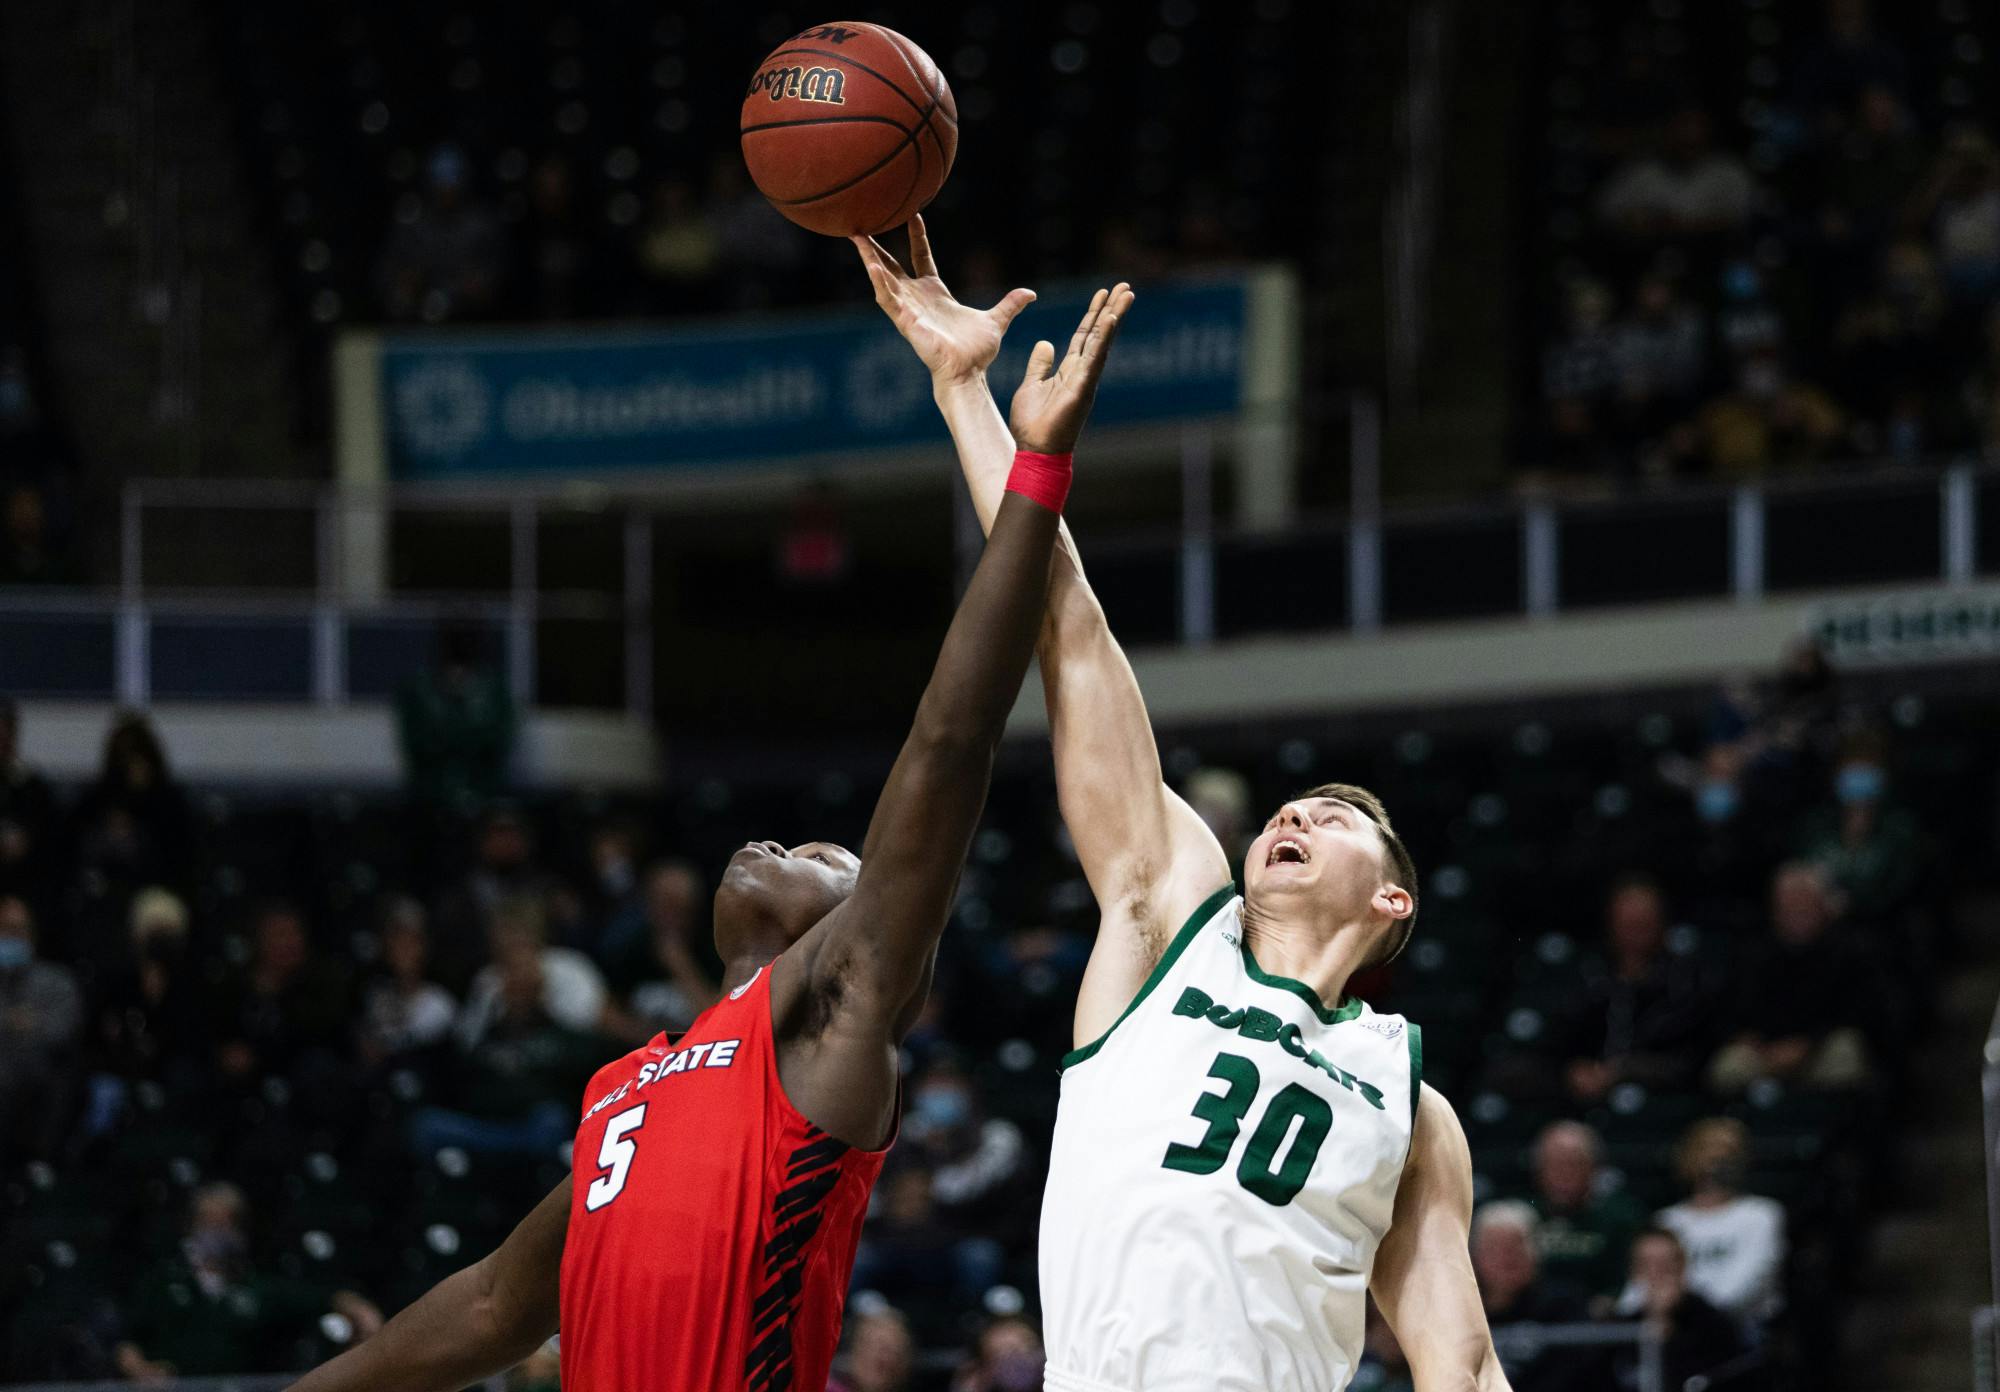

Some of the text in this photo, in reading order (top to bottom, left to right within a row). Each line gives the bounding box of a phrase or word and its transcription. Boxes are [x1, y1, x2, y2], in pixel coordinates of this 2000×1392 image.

[785, 26, 860, 45] NC
[746, 65, 845, 106] Wilso
[636, 1039, 742, 1091] STATE
[1161, 1051, 1333, 1207] 30
[585, 1101, 649, 1214] 5
